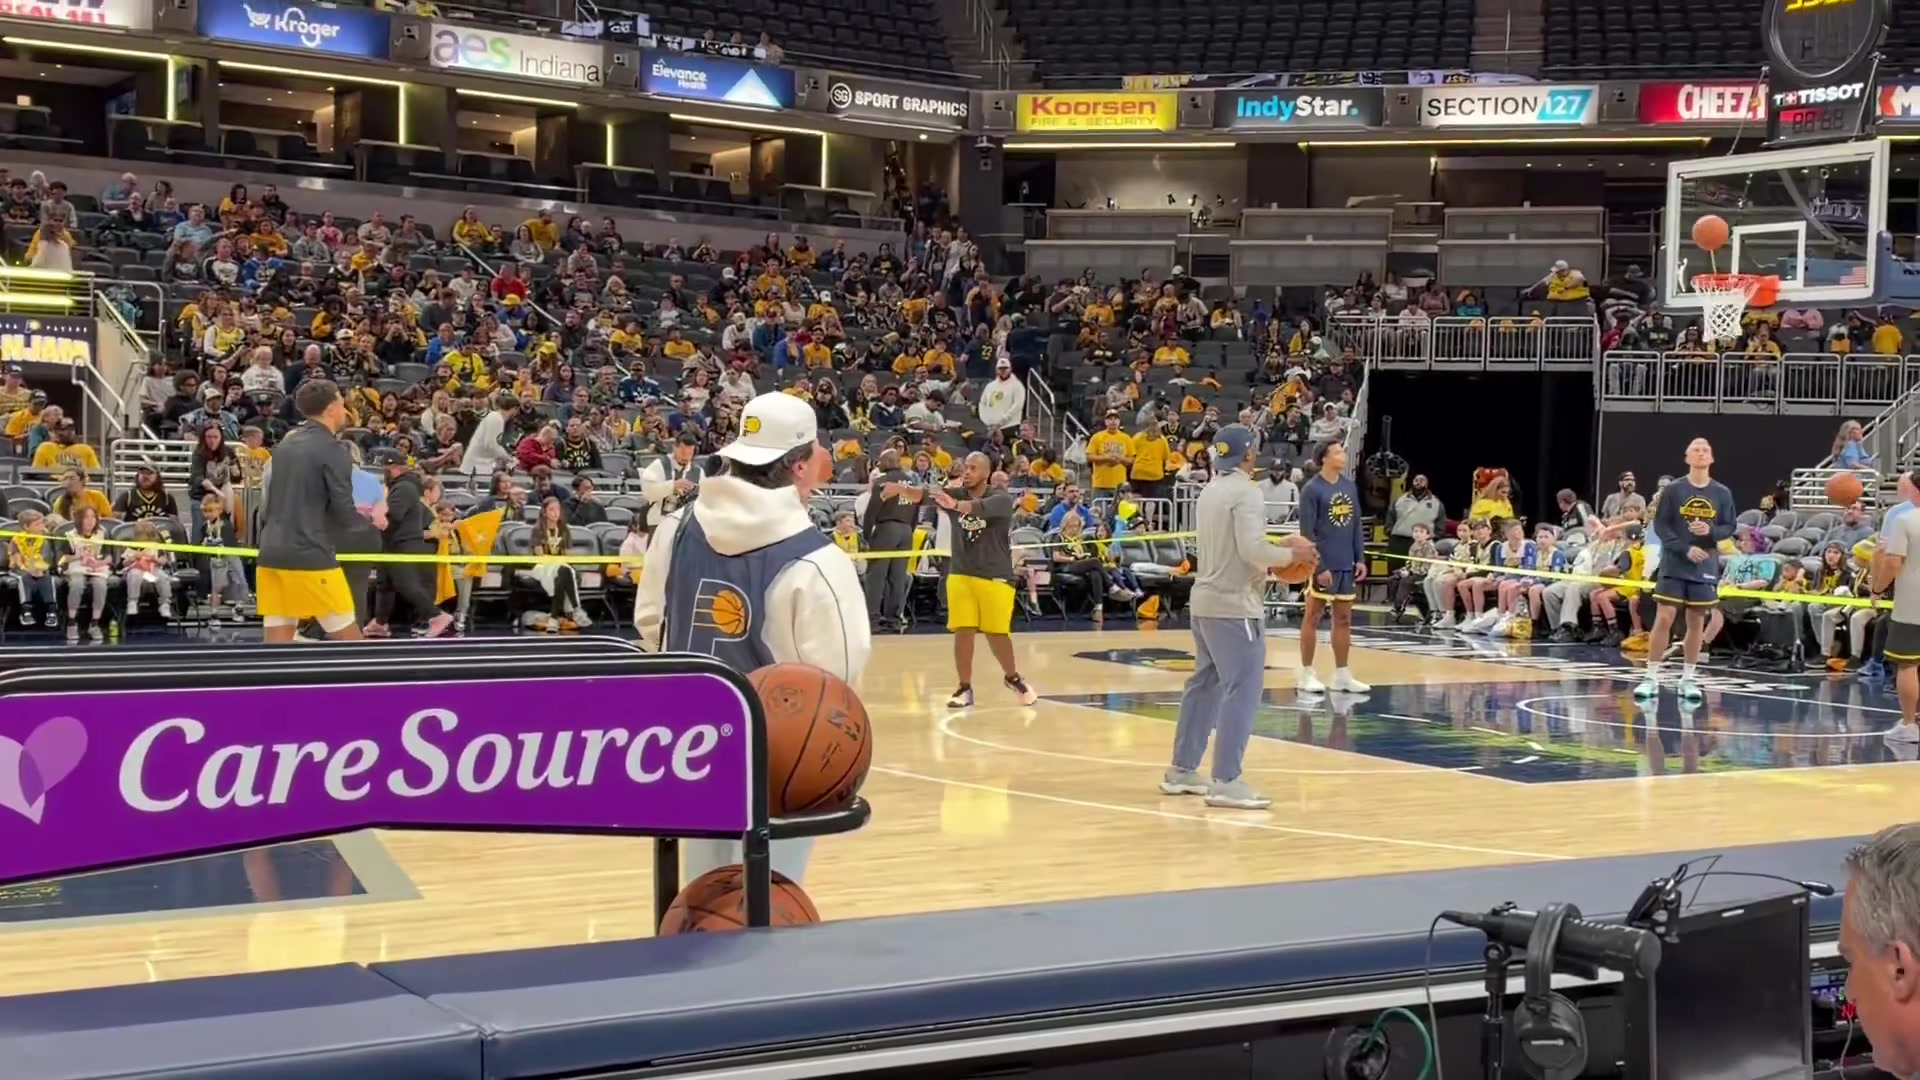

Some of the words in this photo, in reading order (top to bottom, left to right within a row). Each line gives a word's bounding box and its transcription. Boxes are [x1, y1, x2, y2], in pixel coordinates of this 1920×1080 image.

[275, 7, 340, 47] Kroger
[434, 30, 510, 68] aes
[520, 50, 600, 82] Indiana
[652, 64, 707, 81] Elevance
[678, 79, 707, 90] Health
[1797, 82, 1864, 104] TISSOT
[855, 91, 899, 109] SPORT
[902, 97, 967, 116] GRAPHICS
[1031, 97, 1156, 116] Koorsen
[1427, 96, 1538, 117] SECTION
[1545, 95, 1583, 116] 127
[1031, 117, 1060, 126] FIRE
[1086, 117, 1156, 126] SECURITY
